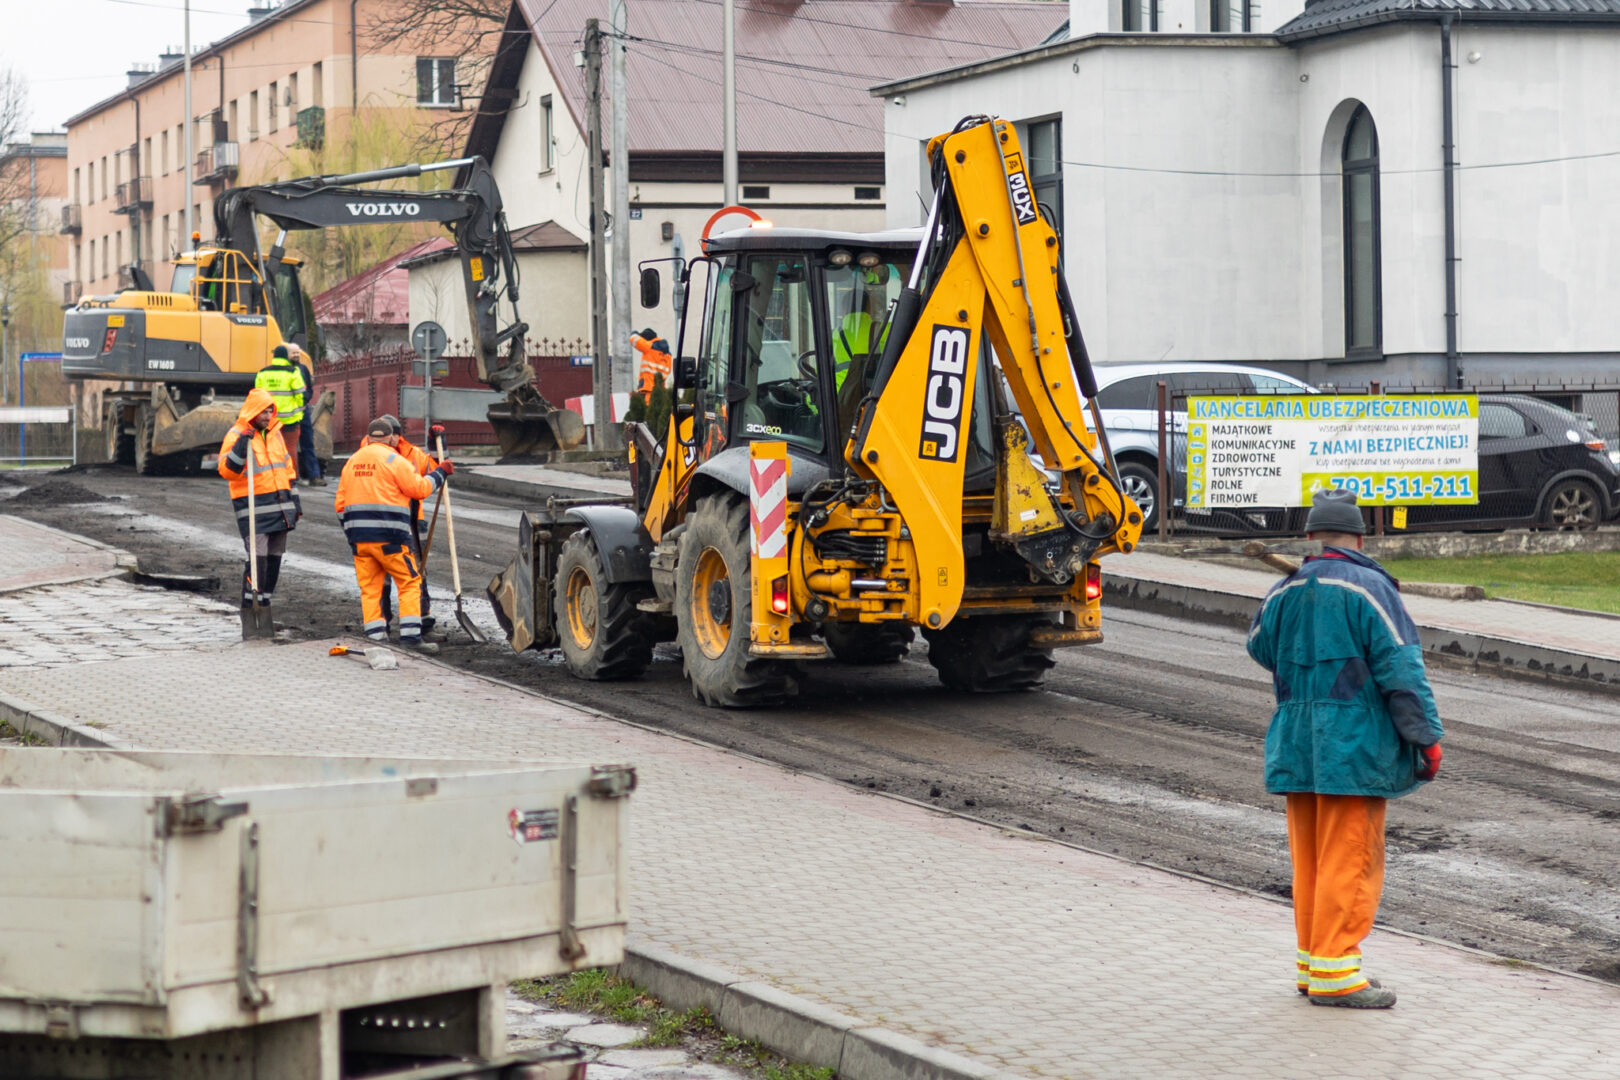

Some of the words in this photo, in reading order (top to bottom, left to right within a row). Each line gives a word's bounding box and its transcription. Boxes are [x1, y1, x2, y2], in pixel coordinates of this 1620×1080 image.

[1009, 172, 1035, 220] 3CX
[345, 203, 420, 216] VOLVO
[65, 337, 90, 348] VOLVO
[924, 329, 967, 459] JCB
[1195, 400, 1304, 418] KANCELARIA
[1309, 400, 1470, 418] UBEZPIECZENIOWA
[746, 424, 782, 435] 3CXeco
[1212, 425, 1273, 438] MAJĄTKOWE
[1211, 440, 1297, 450] KOMUNIKACYJNE
[1309, 441, 1318, 456] Z
[1323, 438, 1362, 455] NAMI
[1367, 434, 1469, 453] BEZPIECZNIEJ!
[1212, 453, 1276, 463] ZDROWOTNE
[1212, 467, 1282, 477] TURYSTYCZNE
[1211, 480, 1243, 490] ROLNE
[1331, 476, 1473, 499] 791-511-211
[1210, 493, 1259, 503] FIRMOWE
